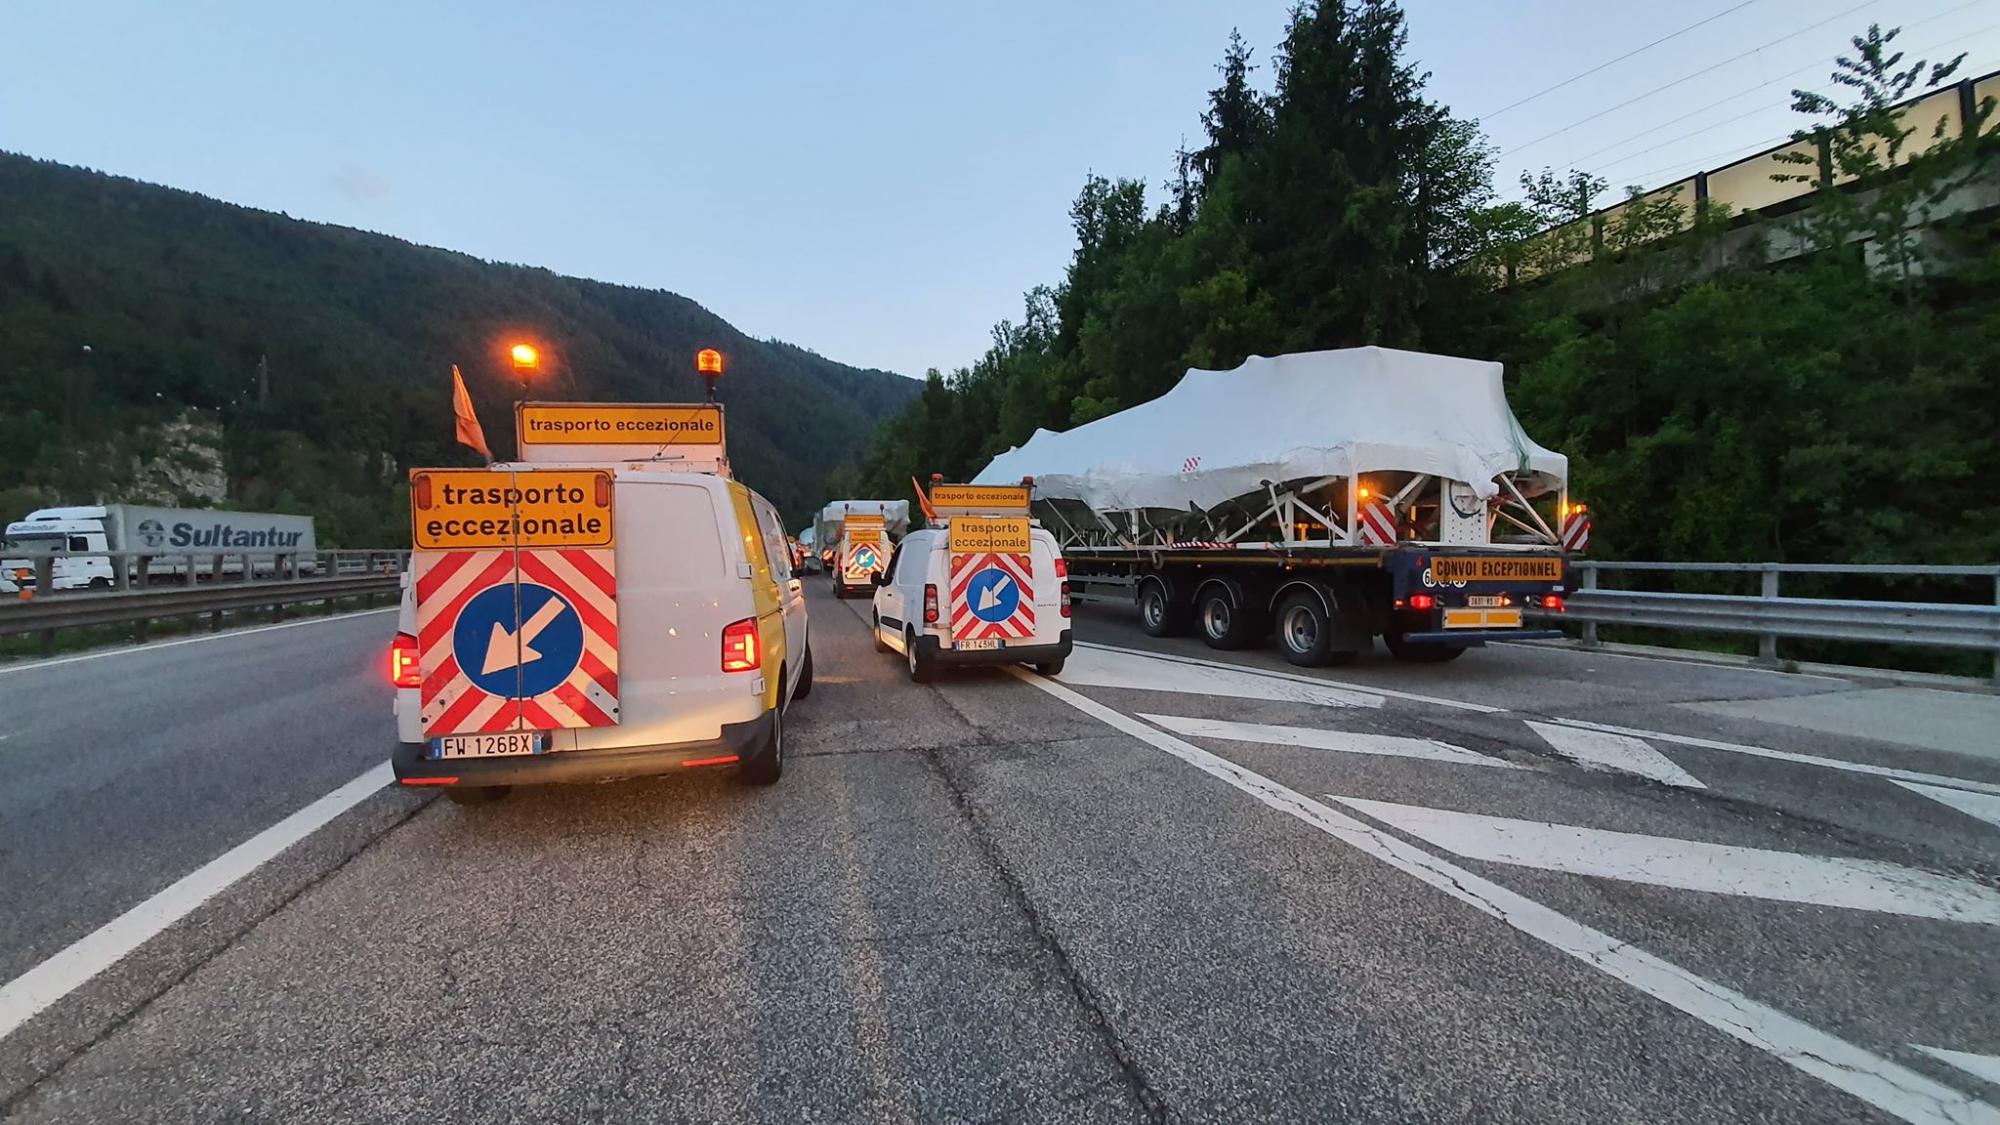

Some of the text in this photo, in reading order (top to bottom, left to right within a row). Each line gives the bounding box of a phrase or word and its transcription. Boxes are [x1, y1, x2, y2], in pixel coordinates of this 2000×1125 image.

[530, 418, 714, 434] trasporto eccezionale
[442, 483, 585, 507] trasporto
[934, 492, 974, 501] trasporto
[426, 513, 602, 536] eccezionale
[961, 523, 1020, 534] trasporto
[169, 522, 303, 547] Sultantur
[954, 536, 1026, 547] eccezionale
[1436, 561, 1557, 576] CONVOI EXCEPTIONNEL
[444, 738, 466, 756] FW
[475, 735, 530, 754] 126BX
